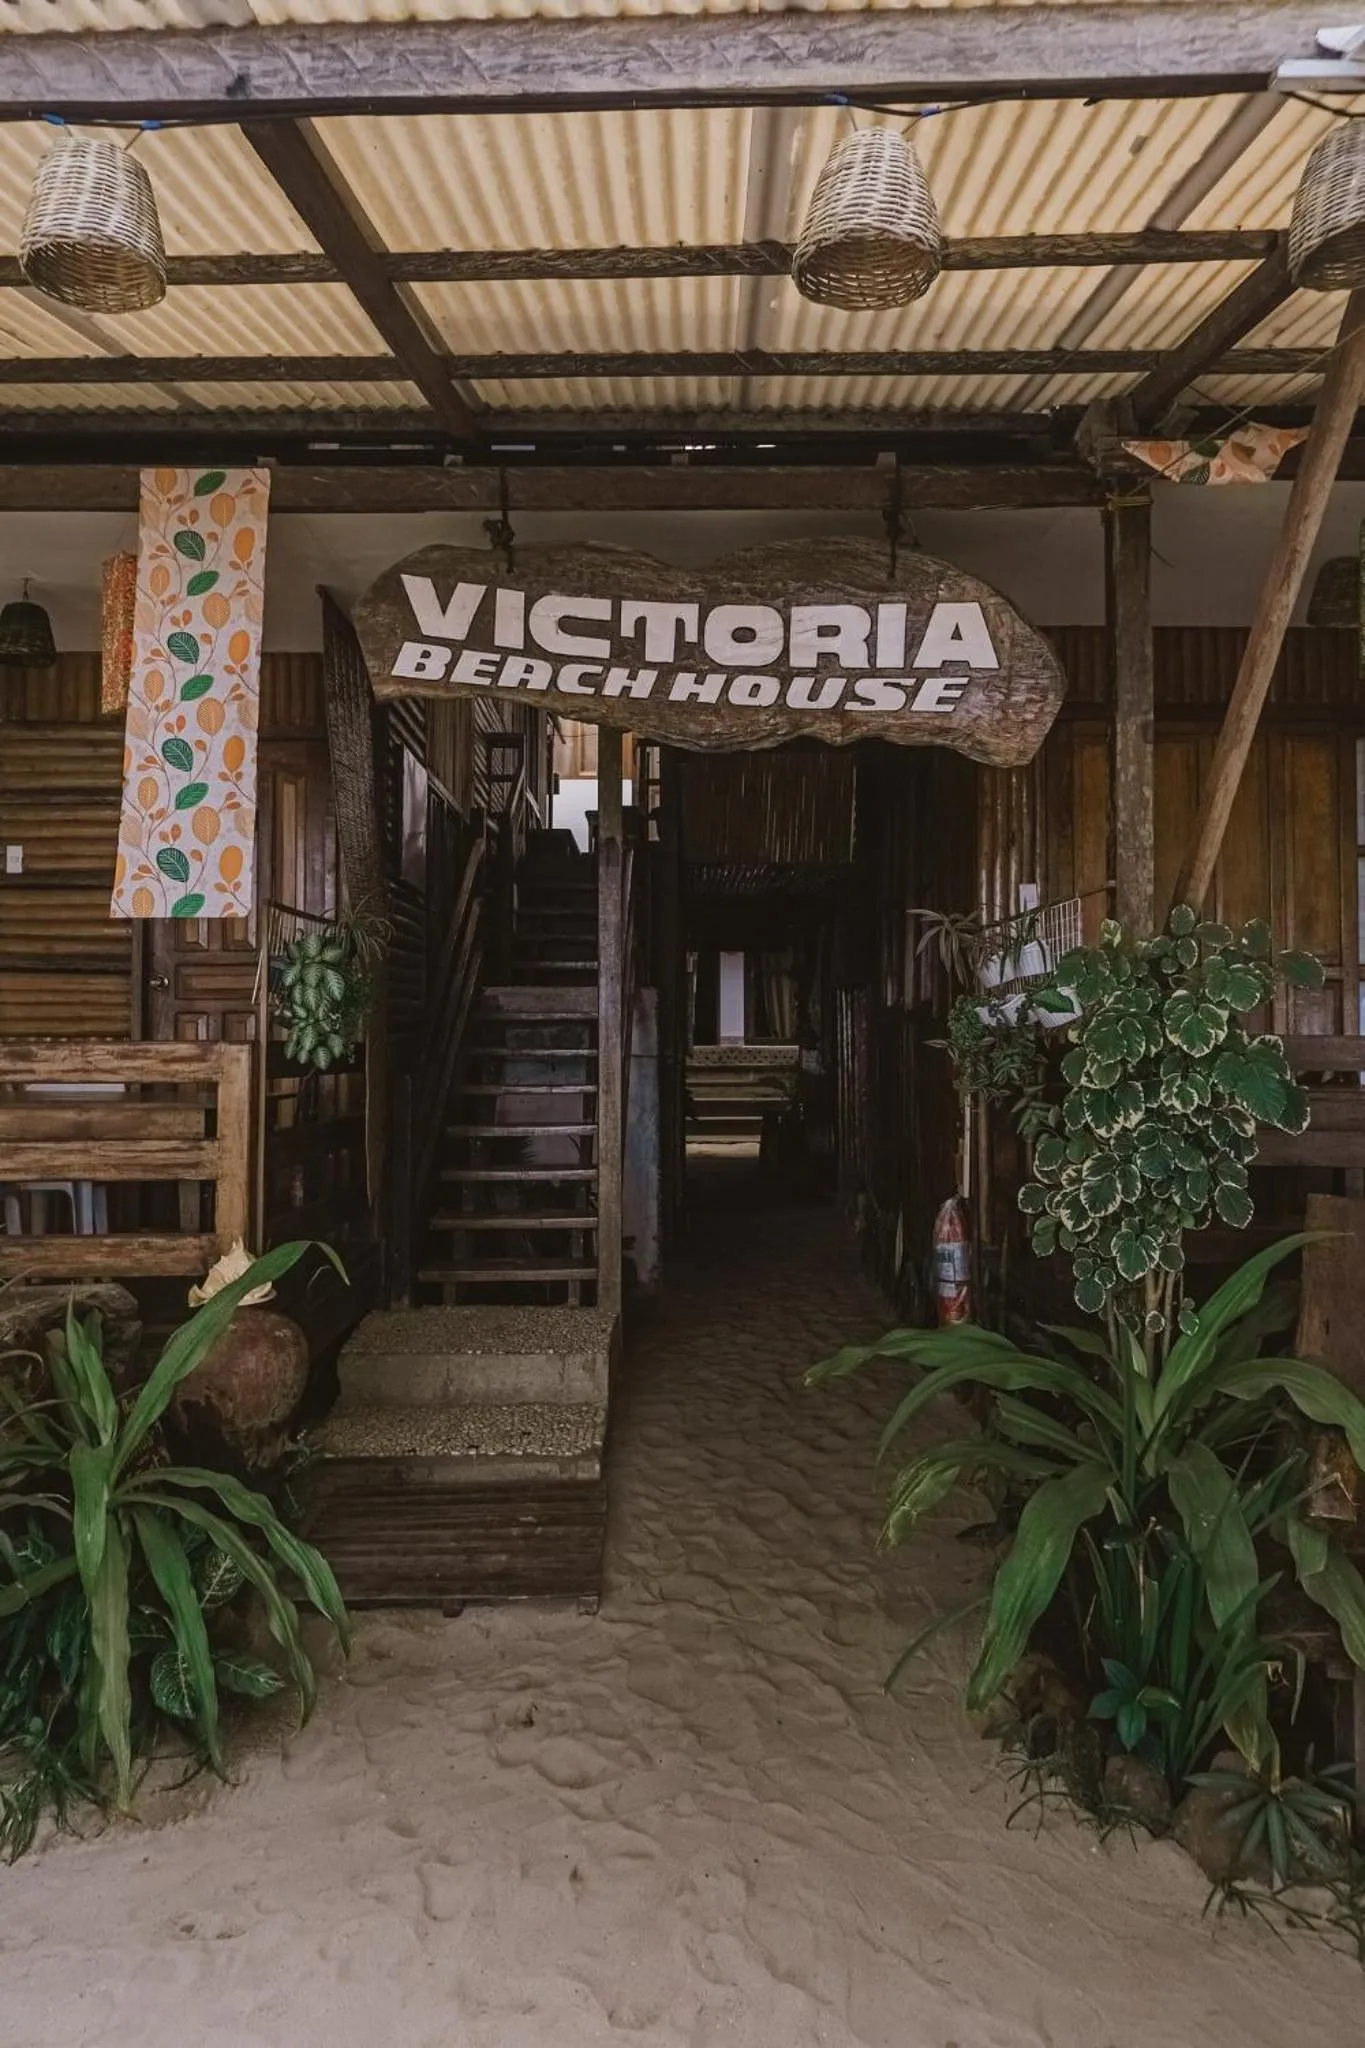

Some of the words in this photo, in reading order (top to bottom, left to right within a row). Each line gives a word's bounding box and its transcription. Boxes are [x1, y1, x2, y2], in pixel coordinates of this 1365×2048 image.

[400, 574, 999, 669] VICTORIA
[391, 642, 658, 699] BEACH
[667, 671, 969, 712] HOUSE
